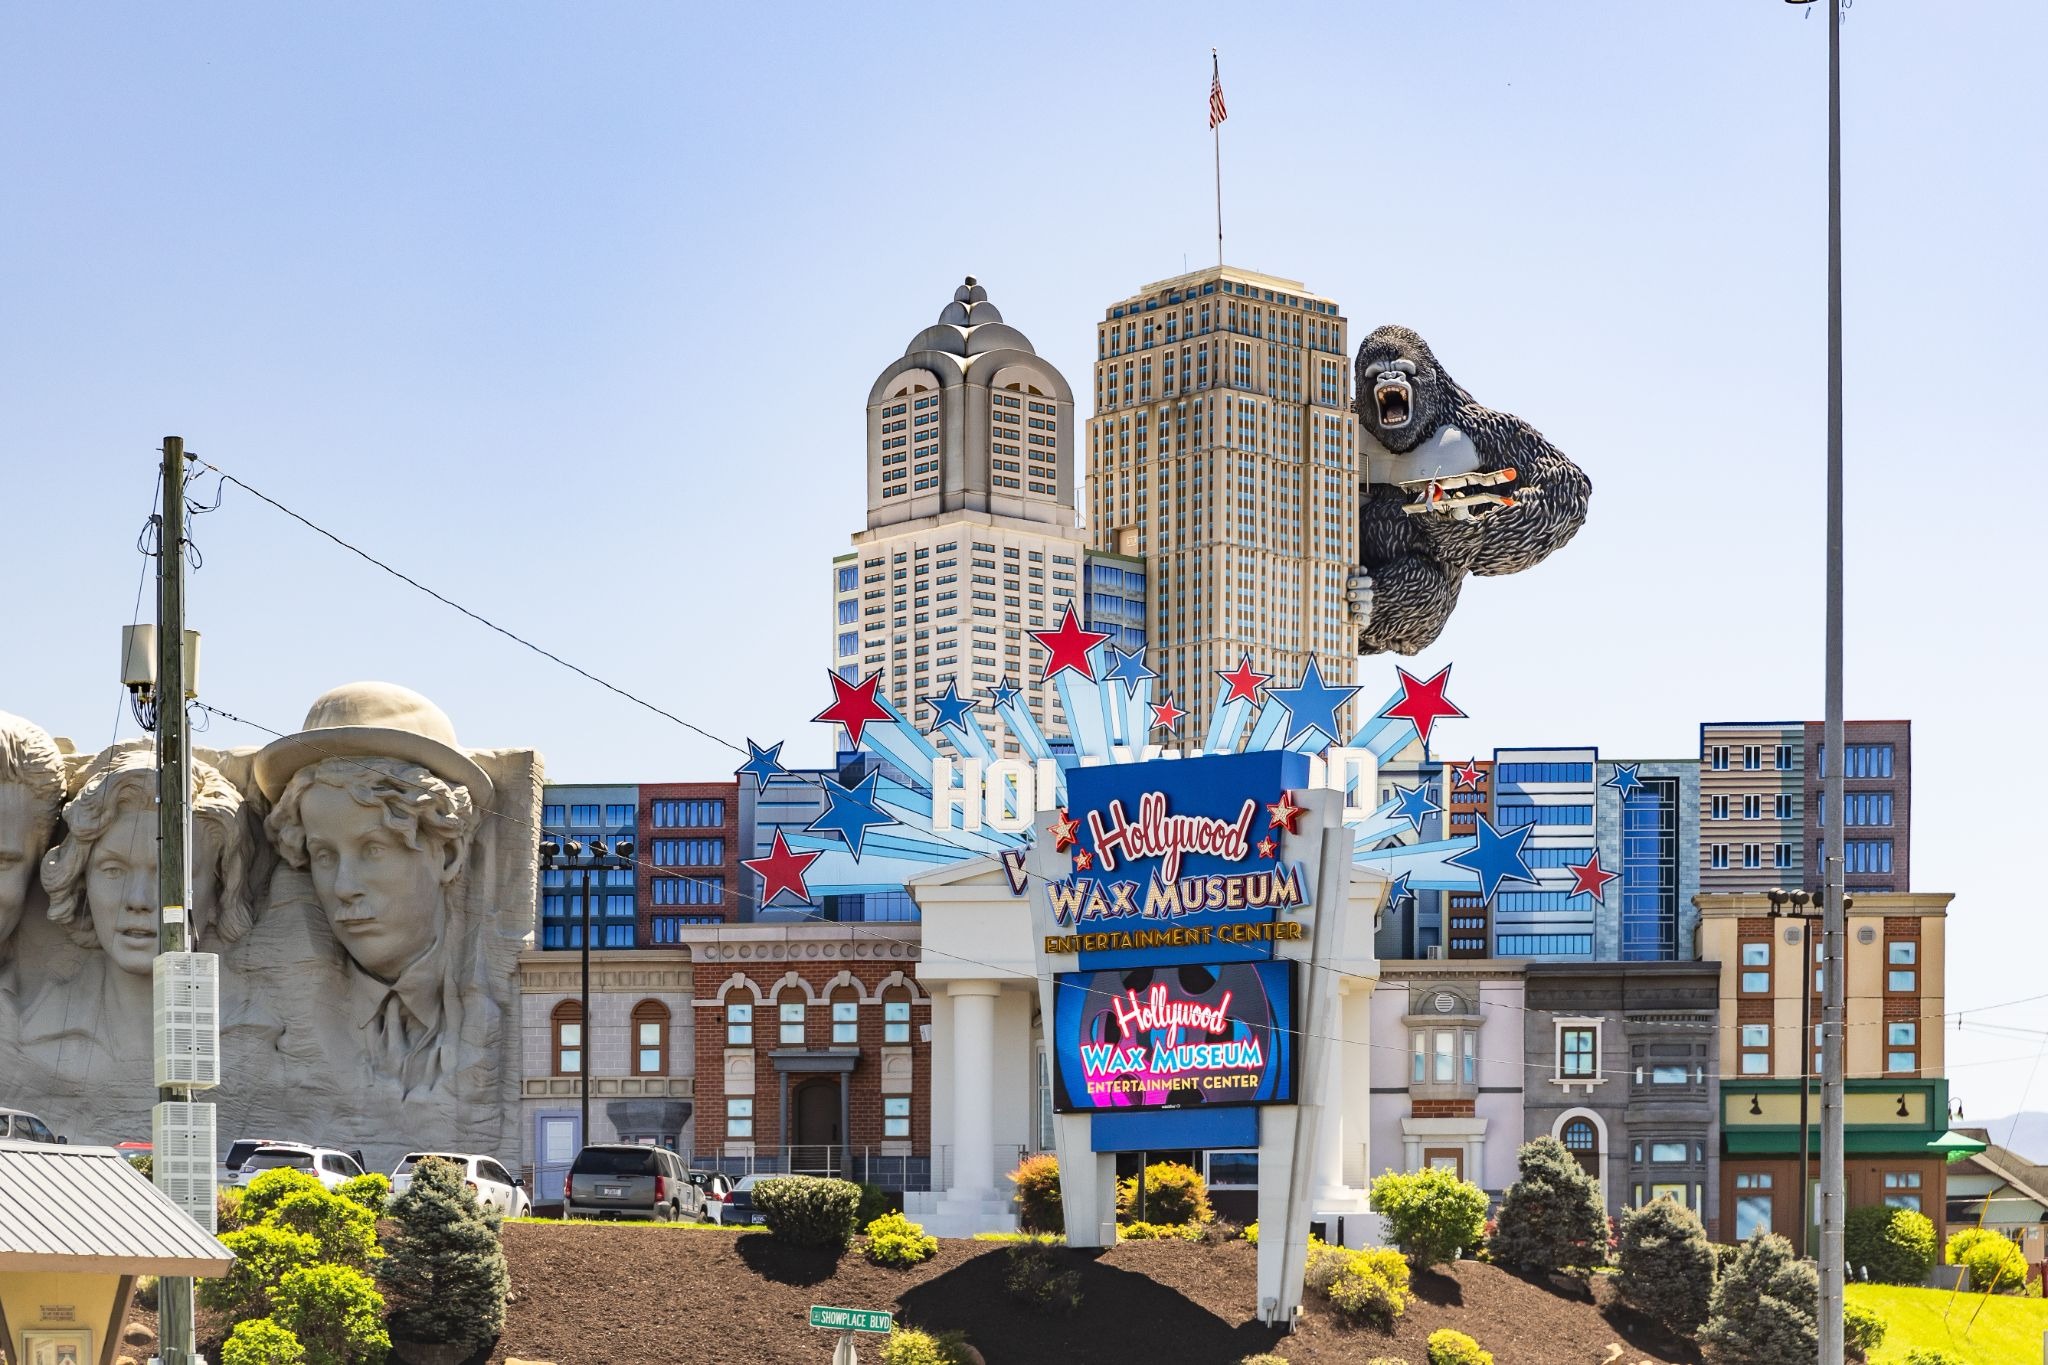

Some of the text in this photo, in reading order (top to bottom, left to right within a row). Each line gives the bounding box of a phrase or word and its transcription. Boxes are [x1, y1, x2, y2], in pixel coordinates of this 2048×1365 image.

[1088, 791, 1257, 885] Hollywood
[1045, 921, 1303, 954] ENTERTAINMENT CENTER
[1112, 981, 1232, 1049] Hollywood
[1087, 1074, 1259, 1095] ENTERTAINMENT CENTER
[820, 1311, 890, 1329] SHOWPLACE BLVD
